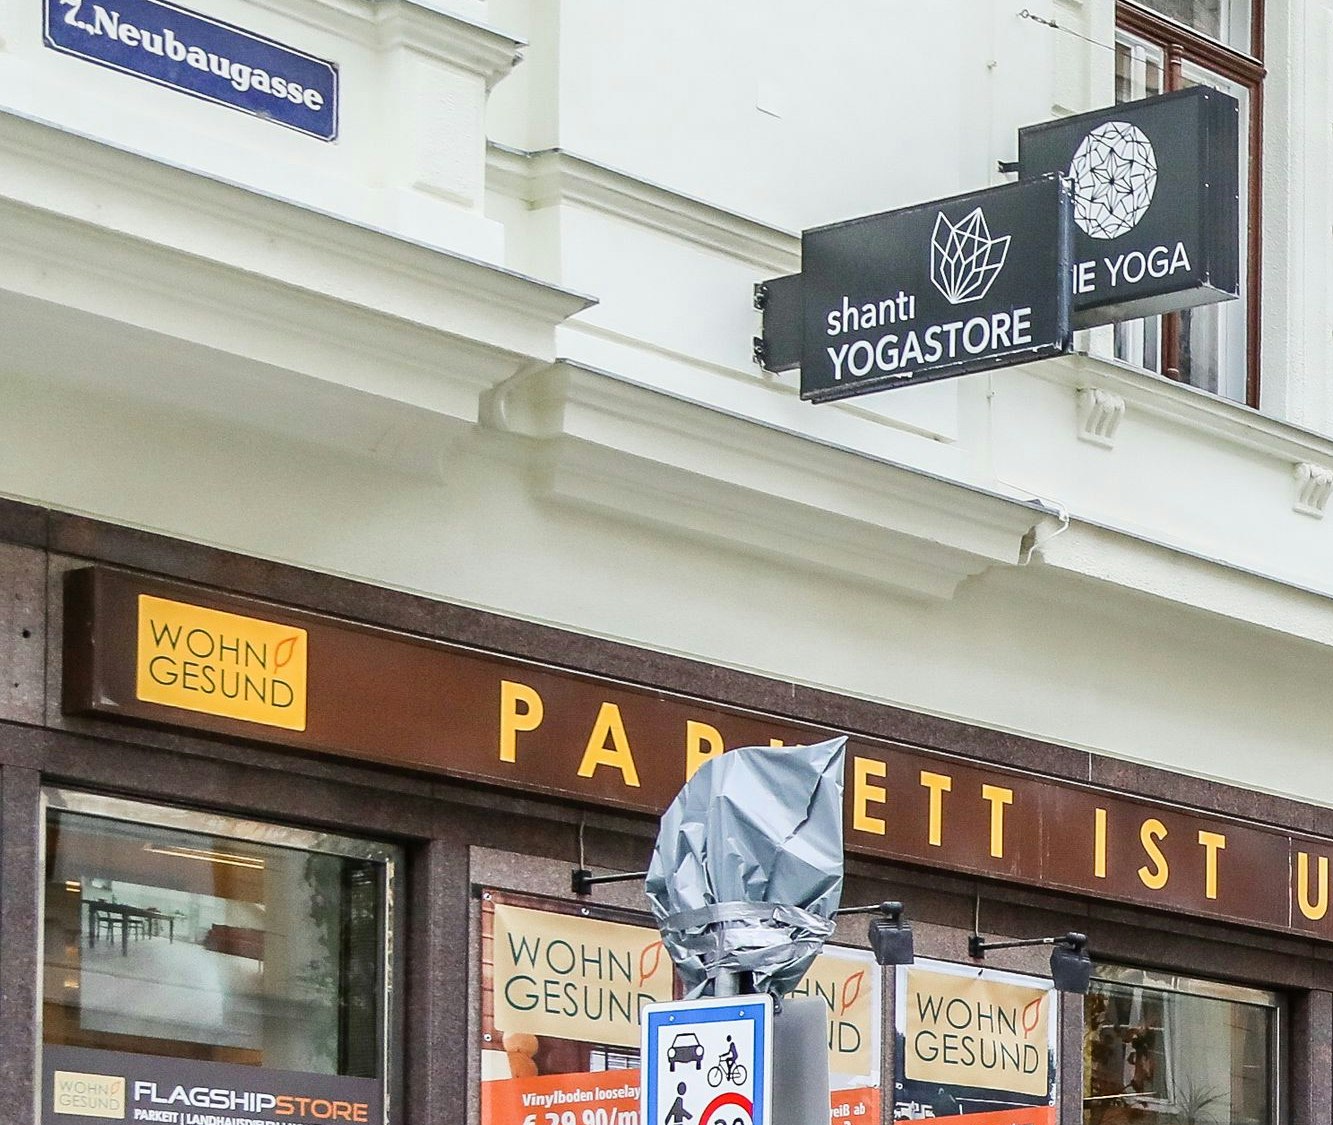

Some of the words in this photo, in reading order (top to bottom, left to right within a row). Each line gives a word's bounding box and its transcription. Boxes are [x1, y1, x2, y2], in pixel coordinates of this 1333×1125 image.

[1104, 241, 1192, 289] YOGA
[827, 291, 915, 339] shanti
[826, 308, 1033, 380] YOGASTORE
[149, 618, 268, 671] WOHN
[148, 655, 295, 709] GESUND
[1093, 808, 1227, 899] IST
[507, 932, 633, 984] WOHN
[916, 991, 1017, 1036] WOHN
[914, 1030, 1039, 1075] GESUND
[59, 1080, 112, 1097] WOHN
[59, 1093, 121, 1112] GESUND
[133, 1080, 369, 1123] FLAGSHIPSTORE
[522, 1088, 594, 1108] Vinylboden
[133, 1108, 178, 1124] PARKETT
